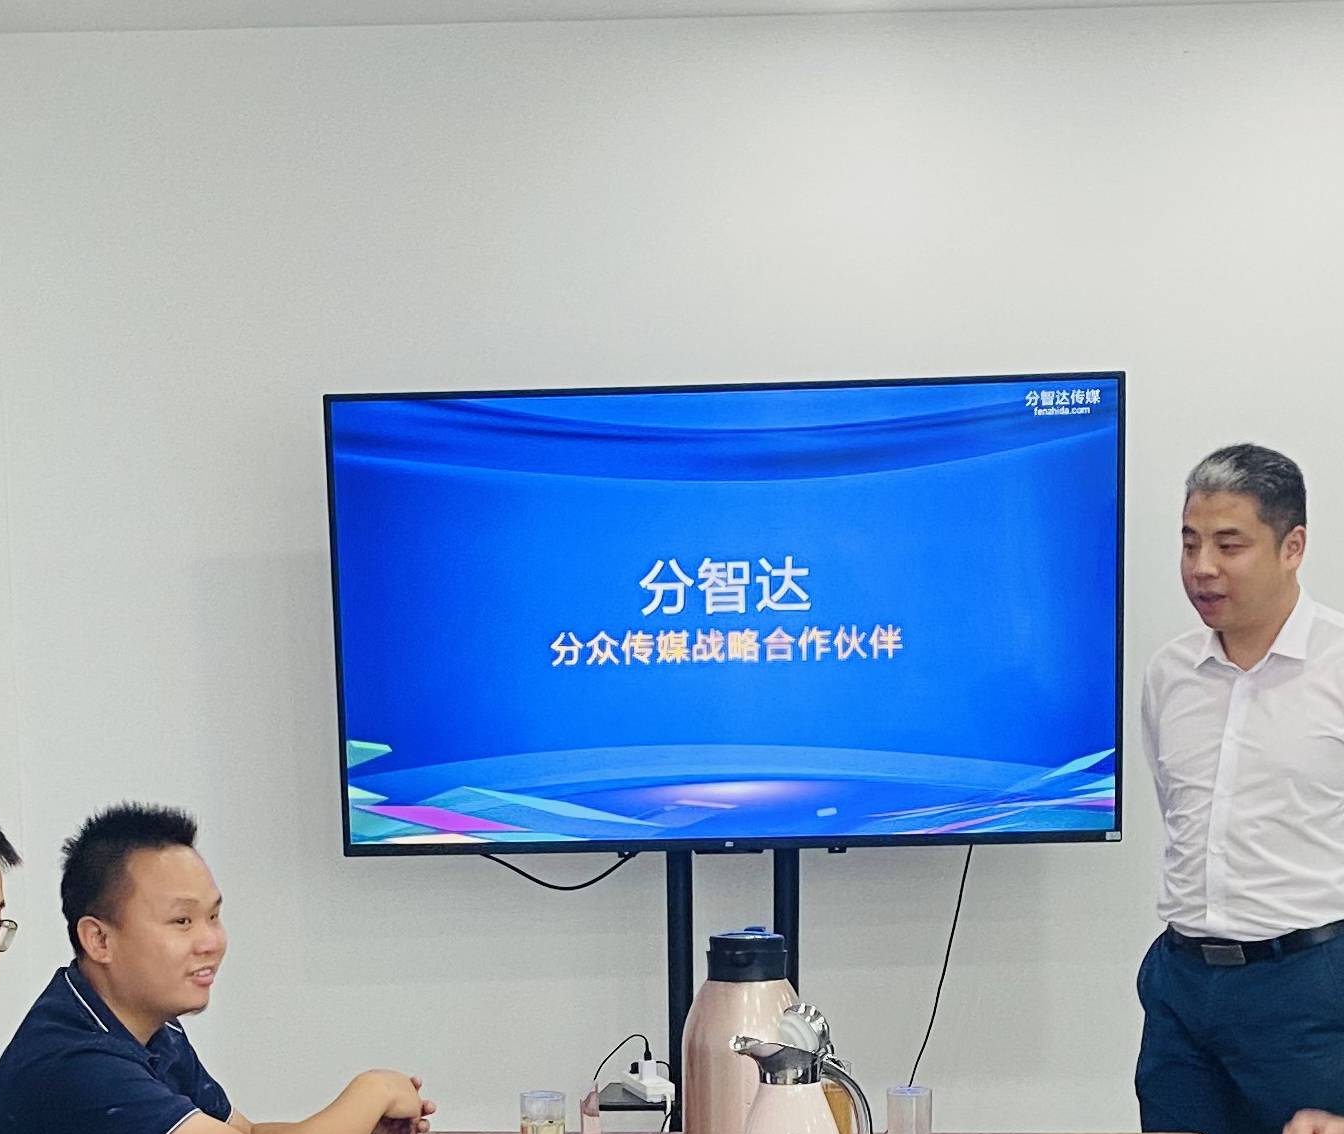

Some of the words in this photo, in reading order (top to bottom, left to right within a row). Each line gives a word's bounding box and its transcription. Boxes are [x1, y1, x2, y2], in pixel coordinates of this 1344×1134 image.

[1025, 388, 1101, 406] 分智达传媒
[639, 555, 812, 616] 分智达
[550, 623, 905, 666] 分众传媒战略合作伙伴
